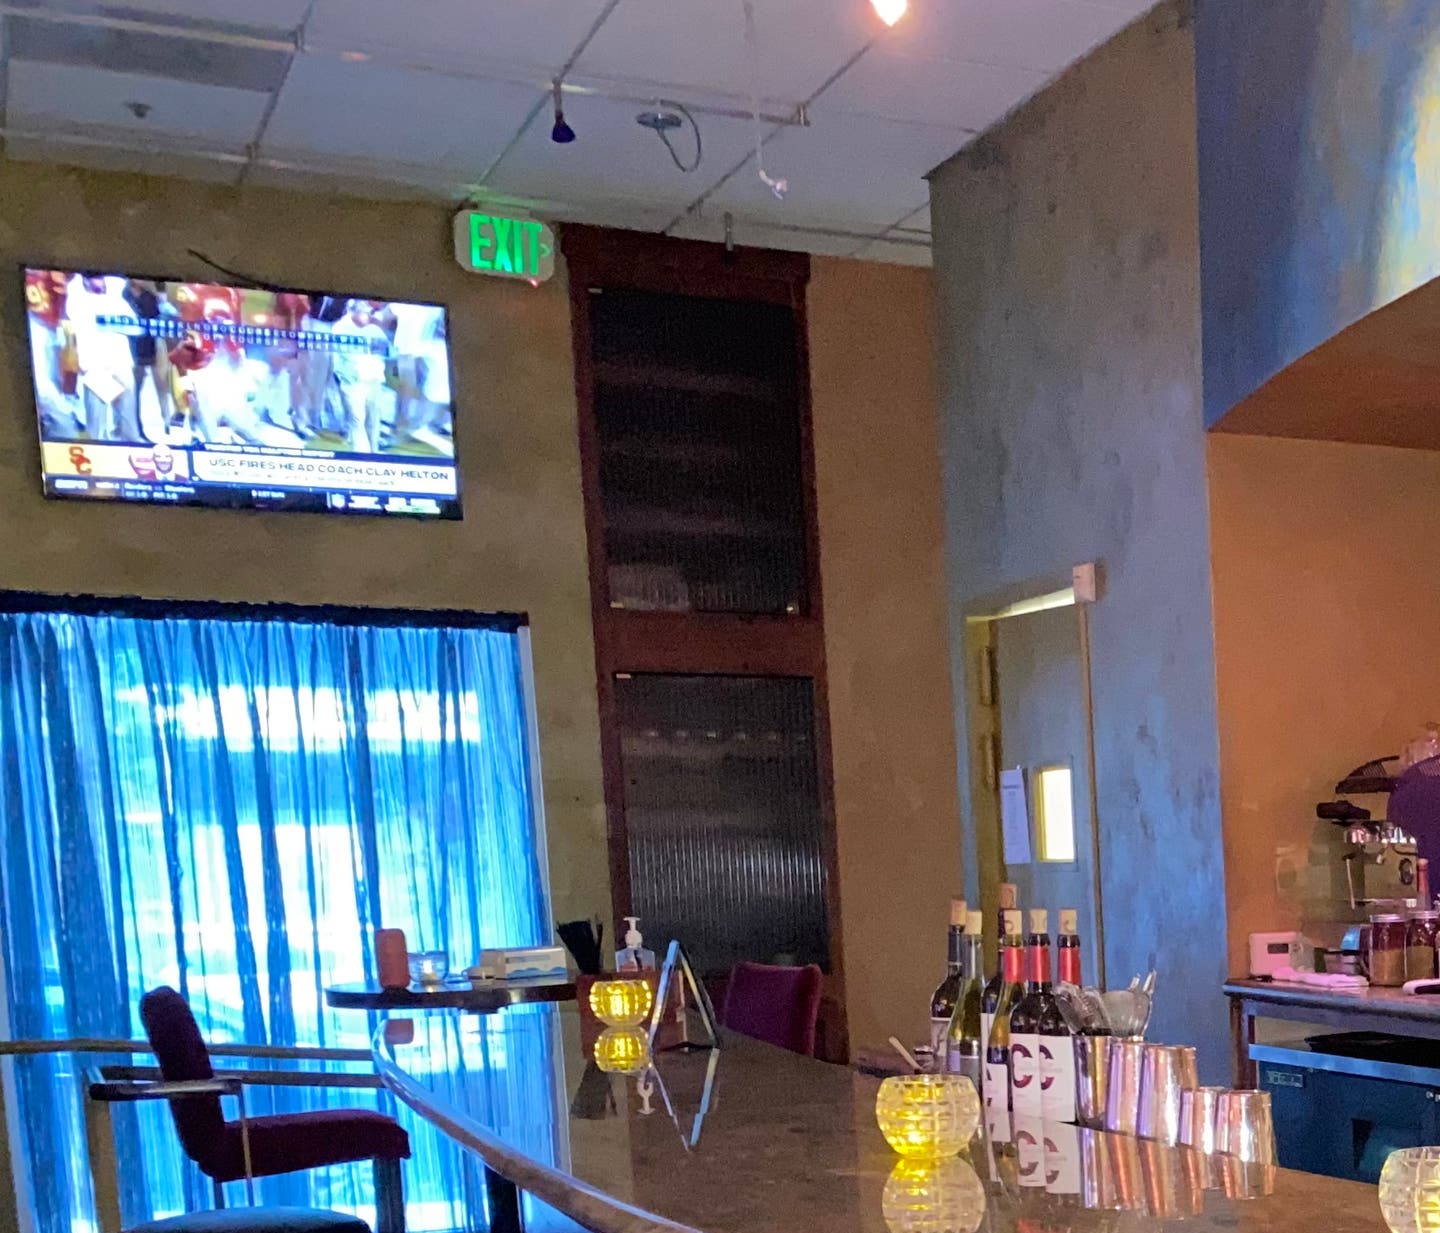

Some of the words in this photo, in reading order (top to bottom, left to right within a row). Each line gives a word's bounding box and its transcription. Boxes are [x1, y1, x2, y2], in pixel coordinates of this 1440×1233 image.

[469, 212, 543, 275] EXIT
[210, 459, 234, 468] USC
[240, 459, 275, 470] FIRES
[279, 462, 315, 472] HEAD
[318, 465, 363, 475] COACH
[366, 467, 397, 477] CLAY
[400, 470, 449, 480] HELTON
